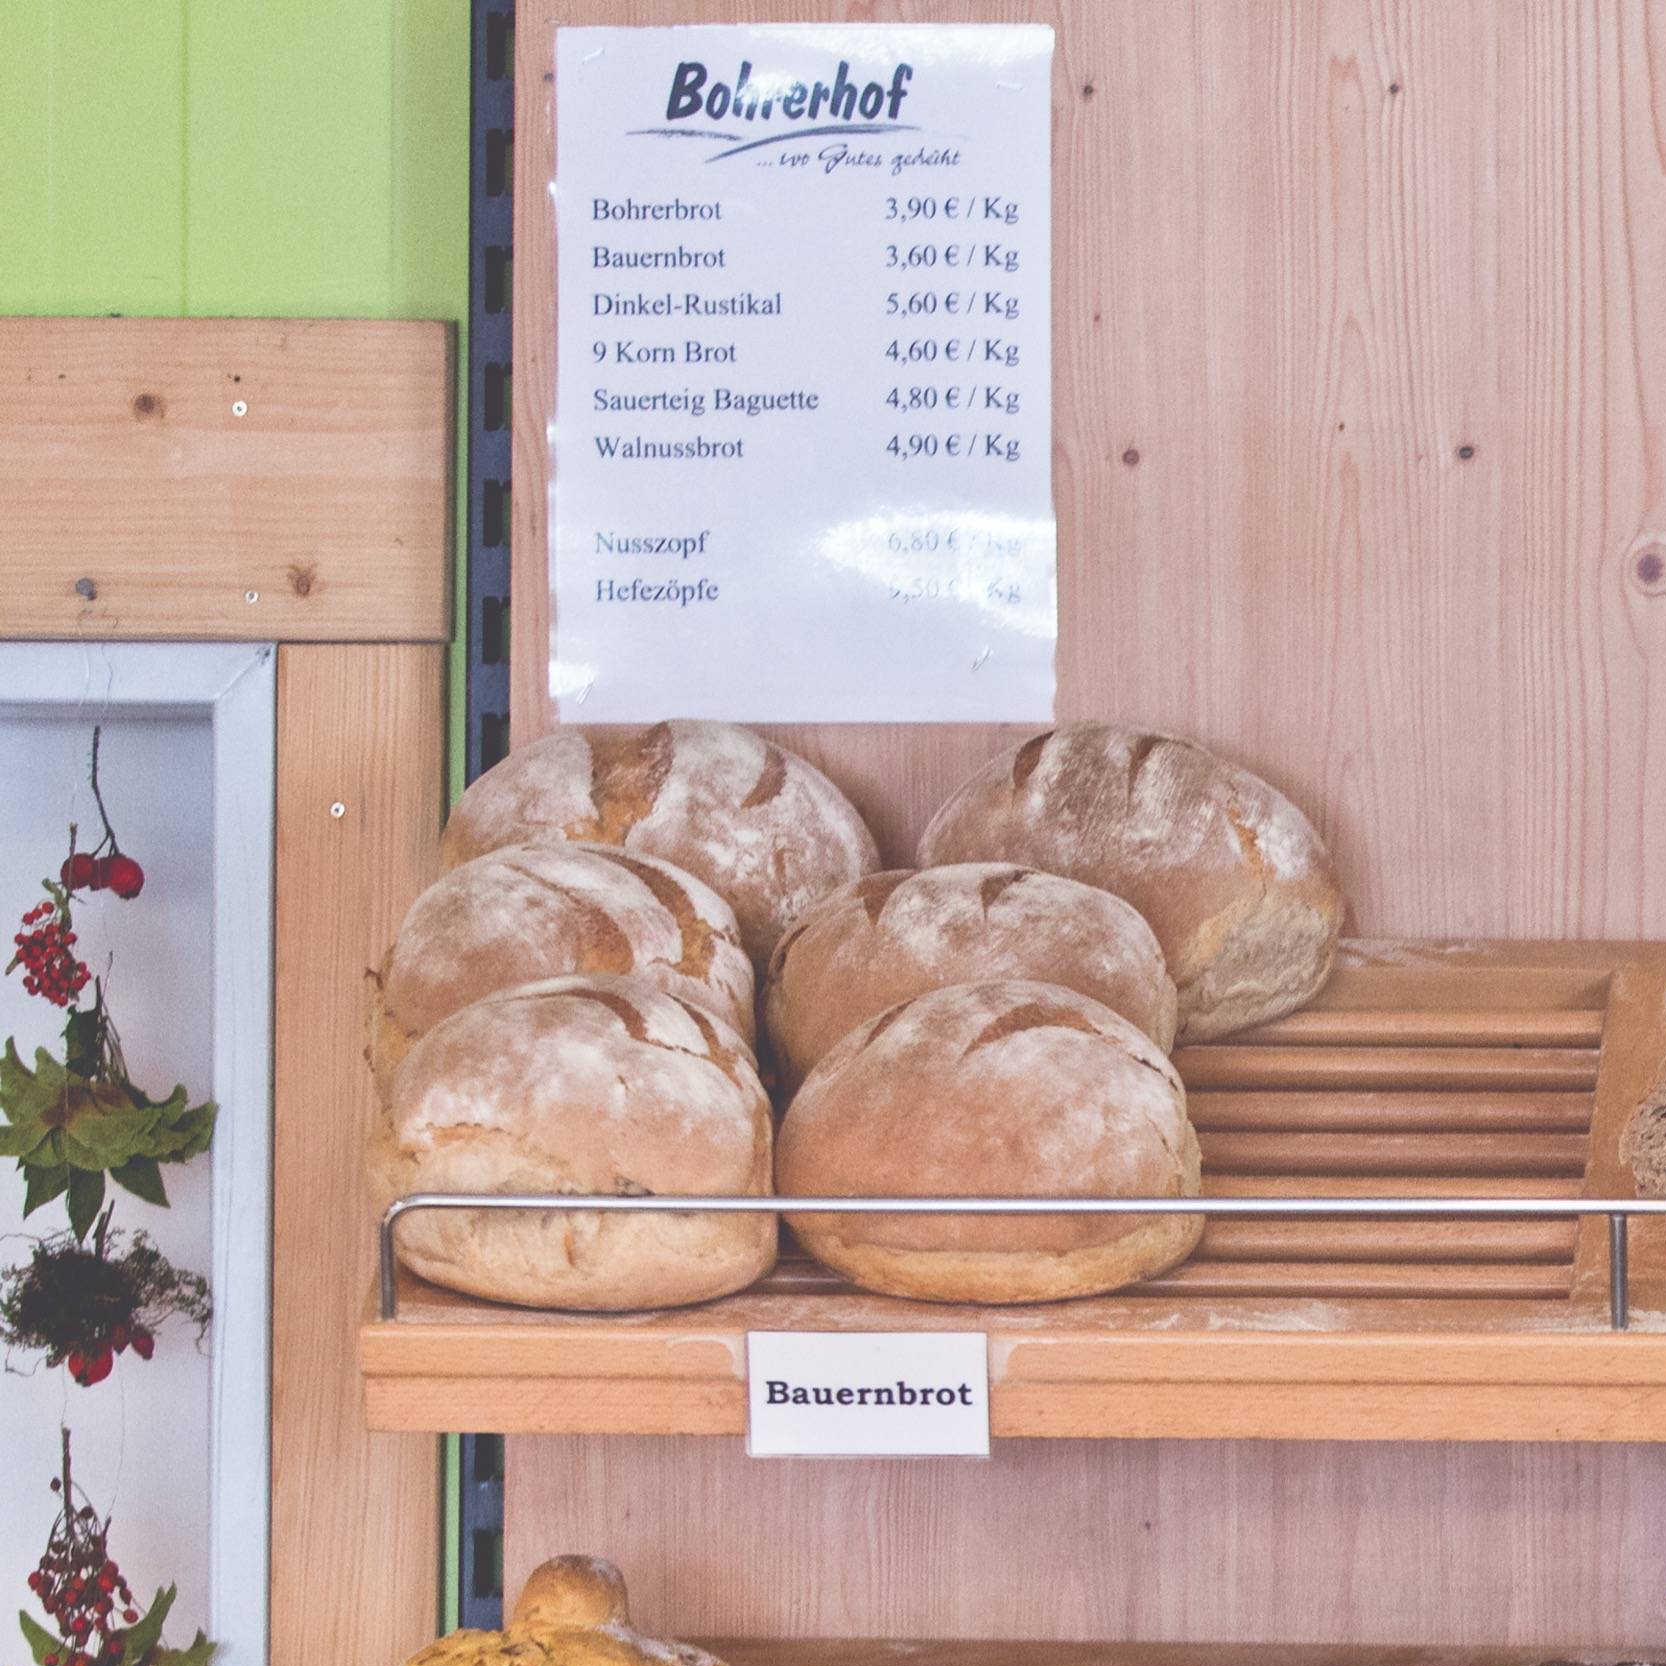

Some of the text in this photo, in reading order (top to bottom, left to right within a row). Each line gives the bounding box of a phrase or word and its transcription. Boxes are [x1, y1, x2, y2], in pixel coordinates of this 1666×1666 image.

[779, 151, 811, 168] wo
[817, 142, 883, 175] Gutes
[890, 146, 961, 177] gedeiht
[591, 197, 722, 222] Bohrerbrot
[885, 197, 938, 224] 3,90
[943, 197, 960, 219] €
[984, 196, 1020, 225] Kg
[591, 245, 726, 270] Bauernbrot
[885, 244, 938, 271] 3,60
[943, 244, 960, 266] €
[984, 243, 1020, 272] Kg
[592, 292, 782, 317] Dinkel-Rustikal
[885, 292, 938, 319] 5,60
[943, 292, 960, 314] €
[984, 291, 1020, 320] Kg
[592, 341, 607, 364] 9
[616, 341, 676, 364] Korn
[685, 340, 737, 364] Brot
[885, 339, 938, 366] 4,60
[943, 339, 960, 361] €
[984, 338, 1020, 367] Kg
[593, 387, 706, 417] Sauerteig
[714, 388, 820, 417] Baguette
[885, 386, 938, 413] 4,80
[943, 386, 960, 408] €
[984, 385, 1020, 414] Kg
[594, 435, 745, 460] Walnussbrot
[885, 434, 938, 461] 4,90
[943, 434, 960, 456] €
[984, 433, 1020, 462] Kg
[594, 530, 711, 559] Nusszopf
[595, 578, 720, 608] Hefezöpfe
[765, 1380, 974, 1407] Bauernbrot
